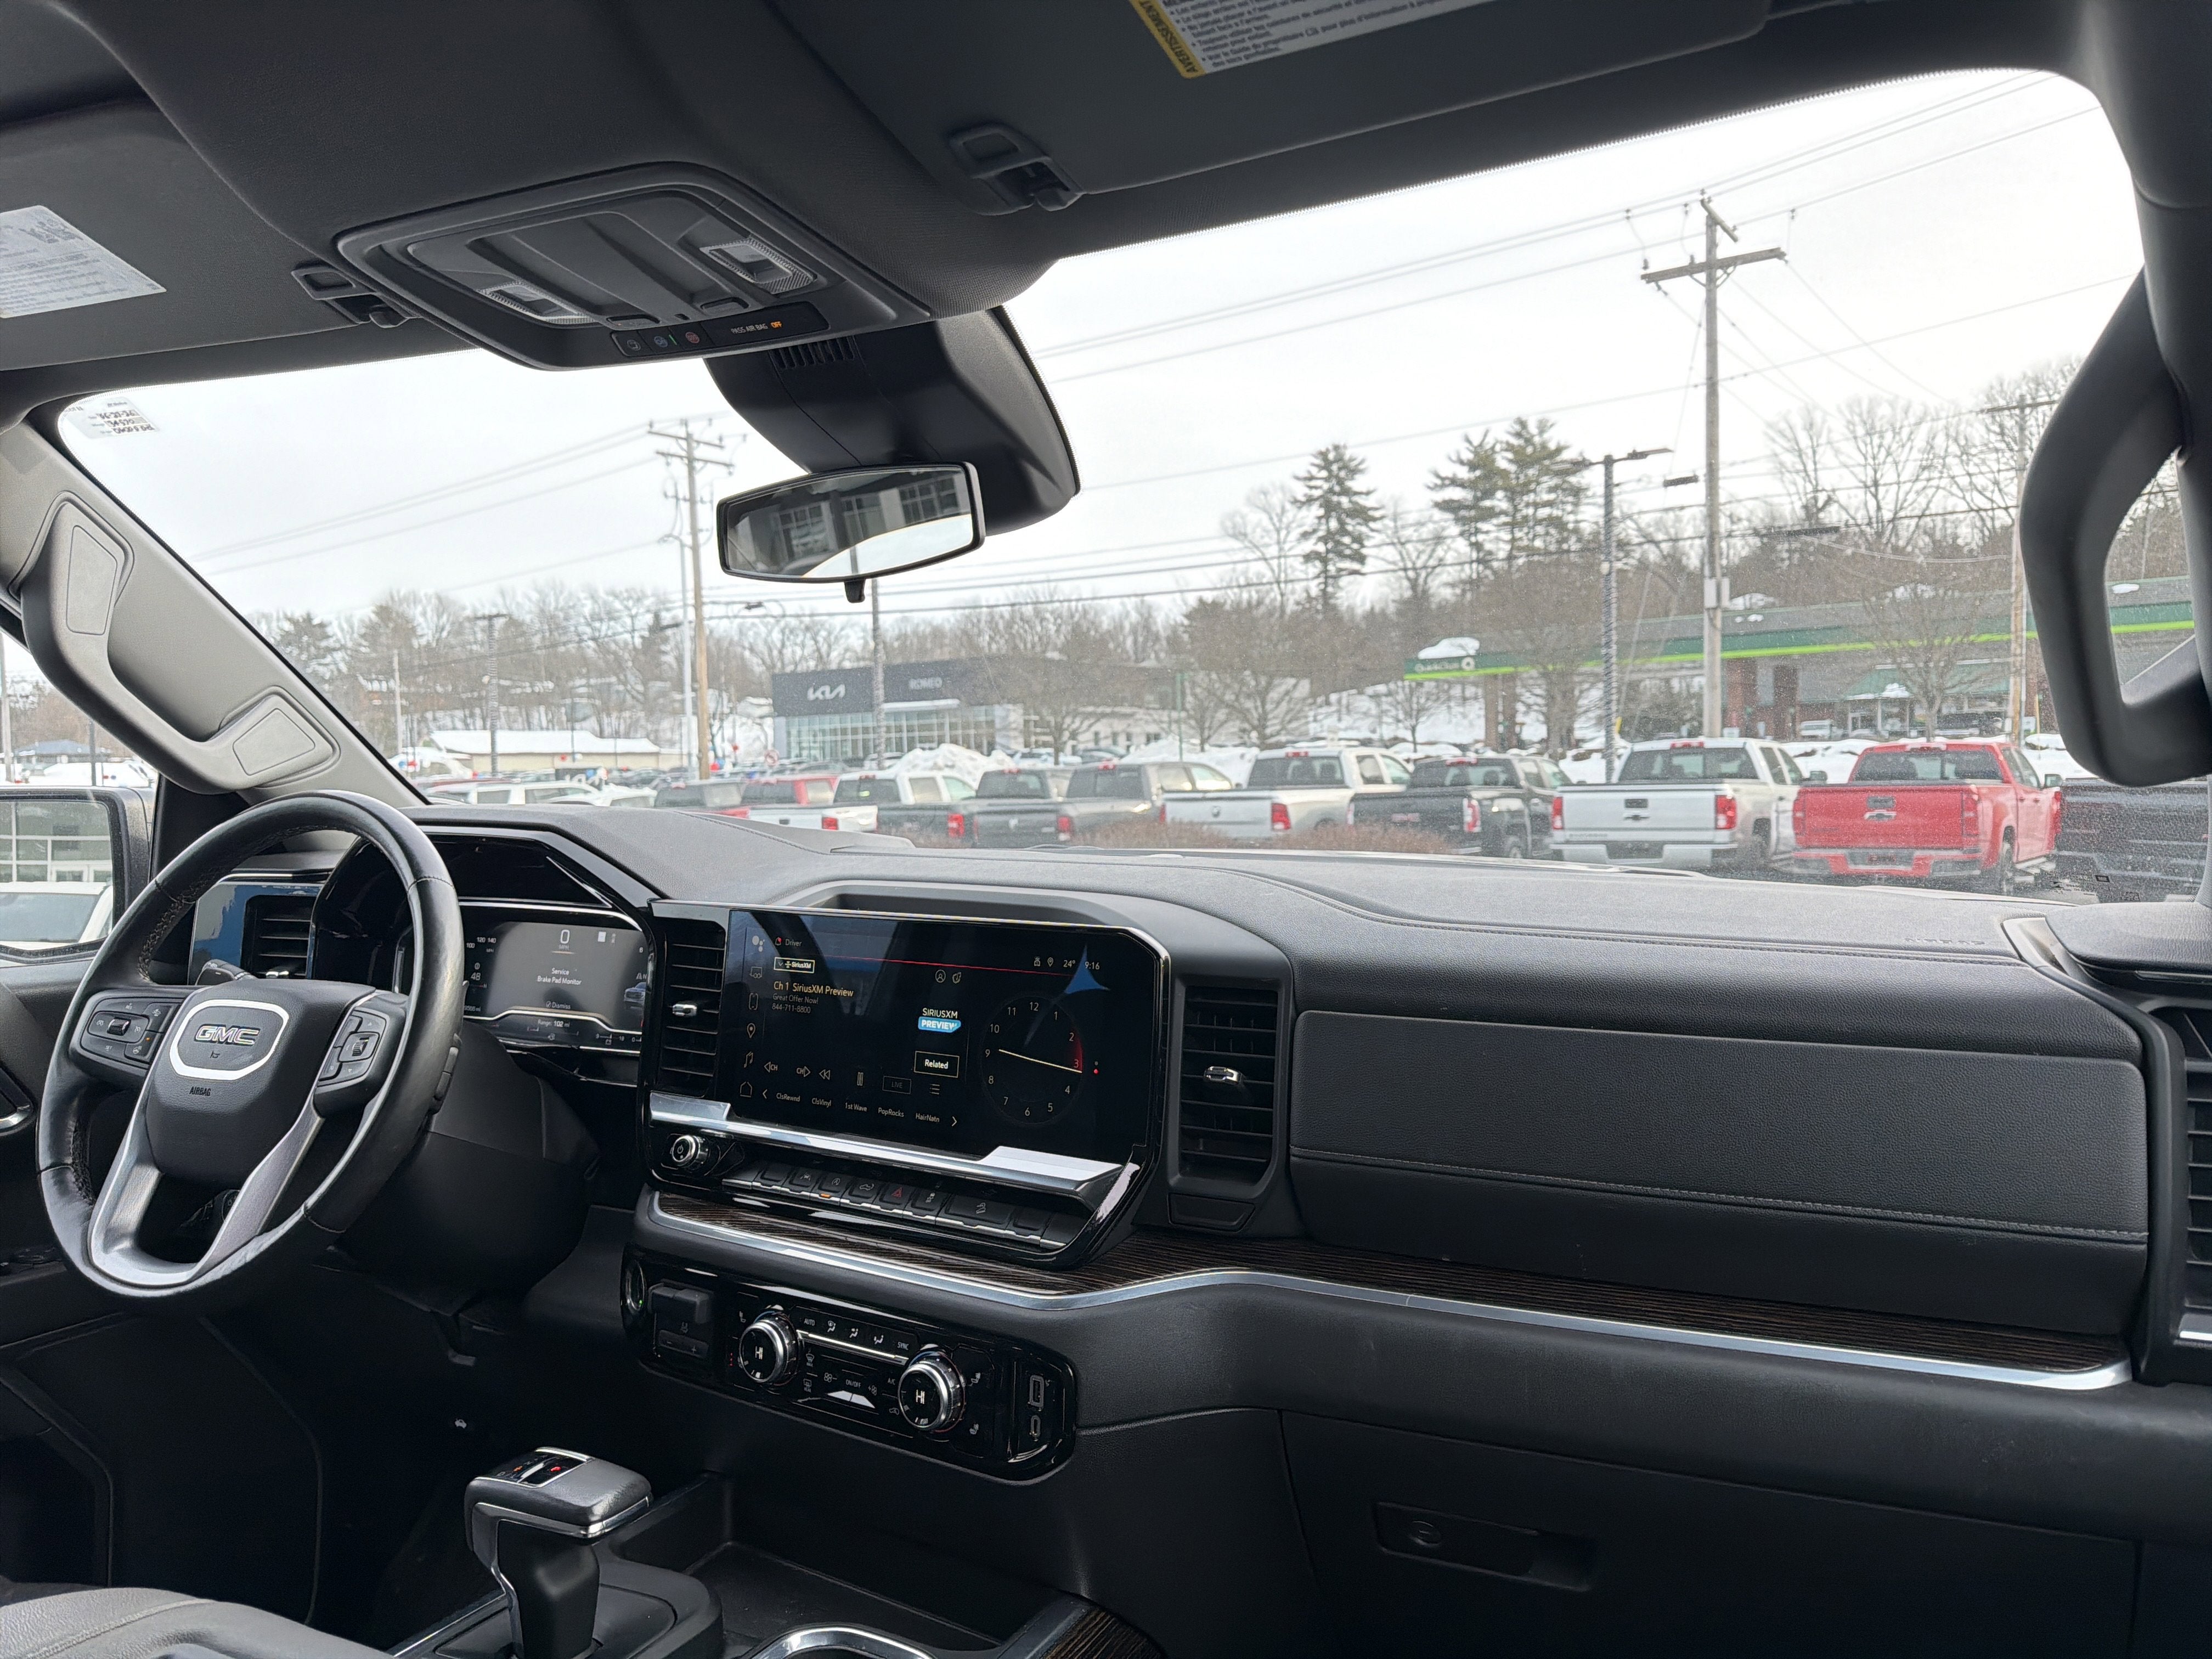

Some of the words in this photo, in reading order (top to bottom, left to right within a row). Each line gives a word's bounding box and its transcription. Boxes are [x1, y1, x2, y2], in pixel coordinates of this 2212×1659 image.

[770, 320, 783, 329] OFF
[560, 929, 570, 944] 0
[785, 939, 802, 947] Driver
[792, 961, 811, 969] SiriusXM
[1085, 961, 1100, 970] 9:16
[551, 967, 569, 975] Service
[774, 981, 784, 990] Ch
[786, 982, 789, 990] 1
[793, 983, 823, 994] SiriusXM
[825, 986, 854, 997] Preview
[552, 1001, 571, 1009] Dismiss
[789, 995, 803, 1003] Offer
[805, 996, 819, 1005] Now!
[772, 1003, 811, 1014] 844-711-8800
[1007, 1007, 1017, 1017] 11
[1029, 1002, 1039, 1012] 12
[922, 1007, 958, 1019] SIRIUSXM
[1053, 1011, 1058, 1020] 1
[921, 1020, 957, 1030] PREVIEW
[990, 1024, 1000, 1033] 10
[195, 1024, 261, 1047] GMC
[1069, 1032, 1074, 1042] 2
[985, 1049, 991, 1058] 9
[924, 1059, 949, 1070] Related
[1073, 1059, 1079, 1068] 3
[988, 1075, 994, 1084] 8
[189, 1086, 211, 1097] AIRBAG
[1064, 1085, 1071, 1094] 4
[776, 1092, 800, 1102] ClsRewnd
[1003, 1097, 1009, 1105] 7
[811, 1098, 832, 1107] ClsVinyl
[845, 1102, 853, 1110] 1st
[854, 1103, 867, 1112] Wave
[1047, 1103, 1053, 1112] 5
[878, 1107, 905, 1118] PopRocks
[1024, 1107, 1030, 1116] 6
[916, 1113, 940, 1123] HairNatn
[804, 1318, 815, 1327] AUTO
[897, 1341, 909, 1351] SYNC
[845, 1379, 861, 1389] ON/OFF
[887, 1377, 896, 1386] A/C
[916, 1389, 925, 1405] HI
